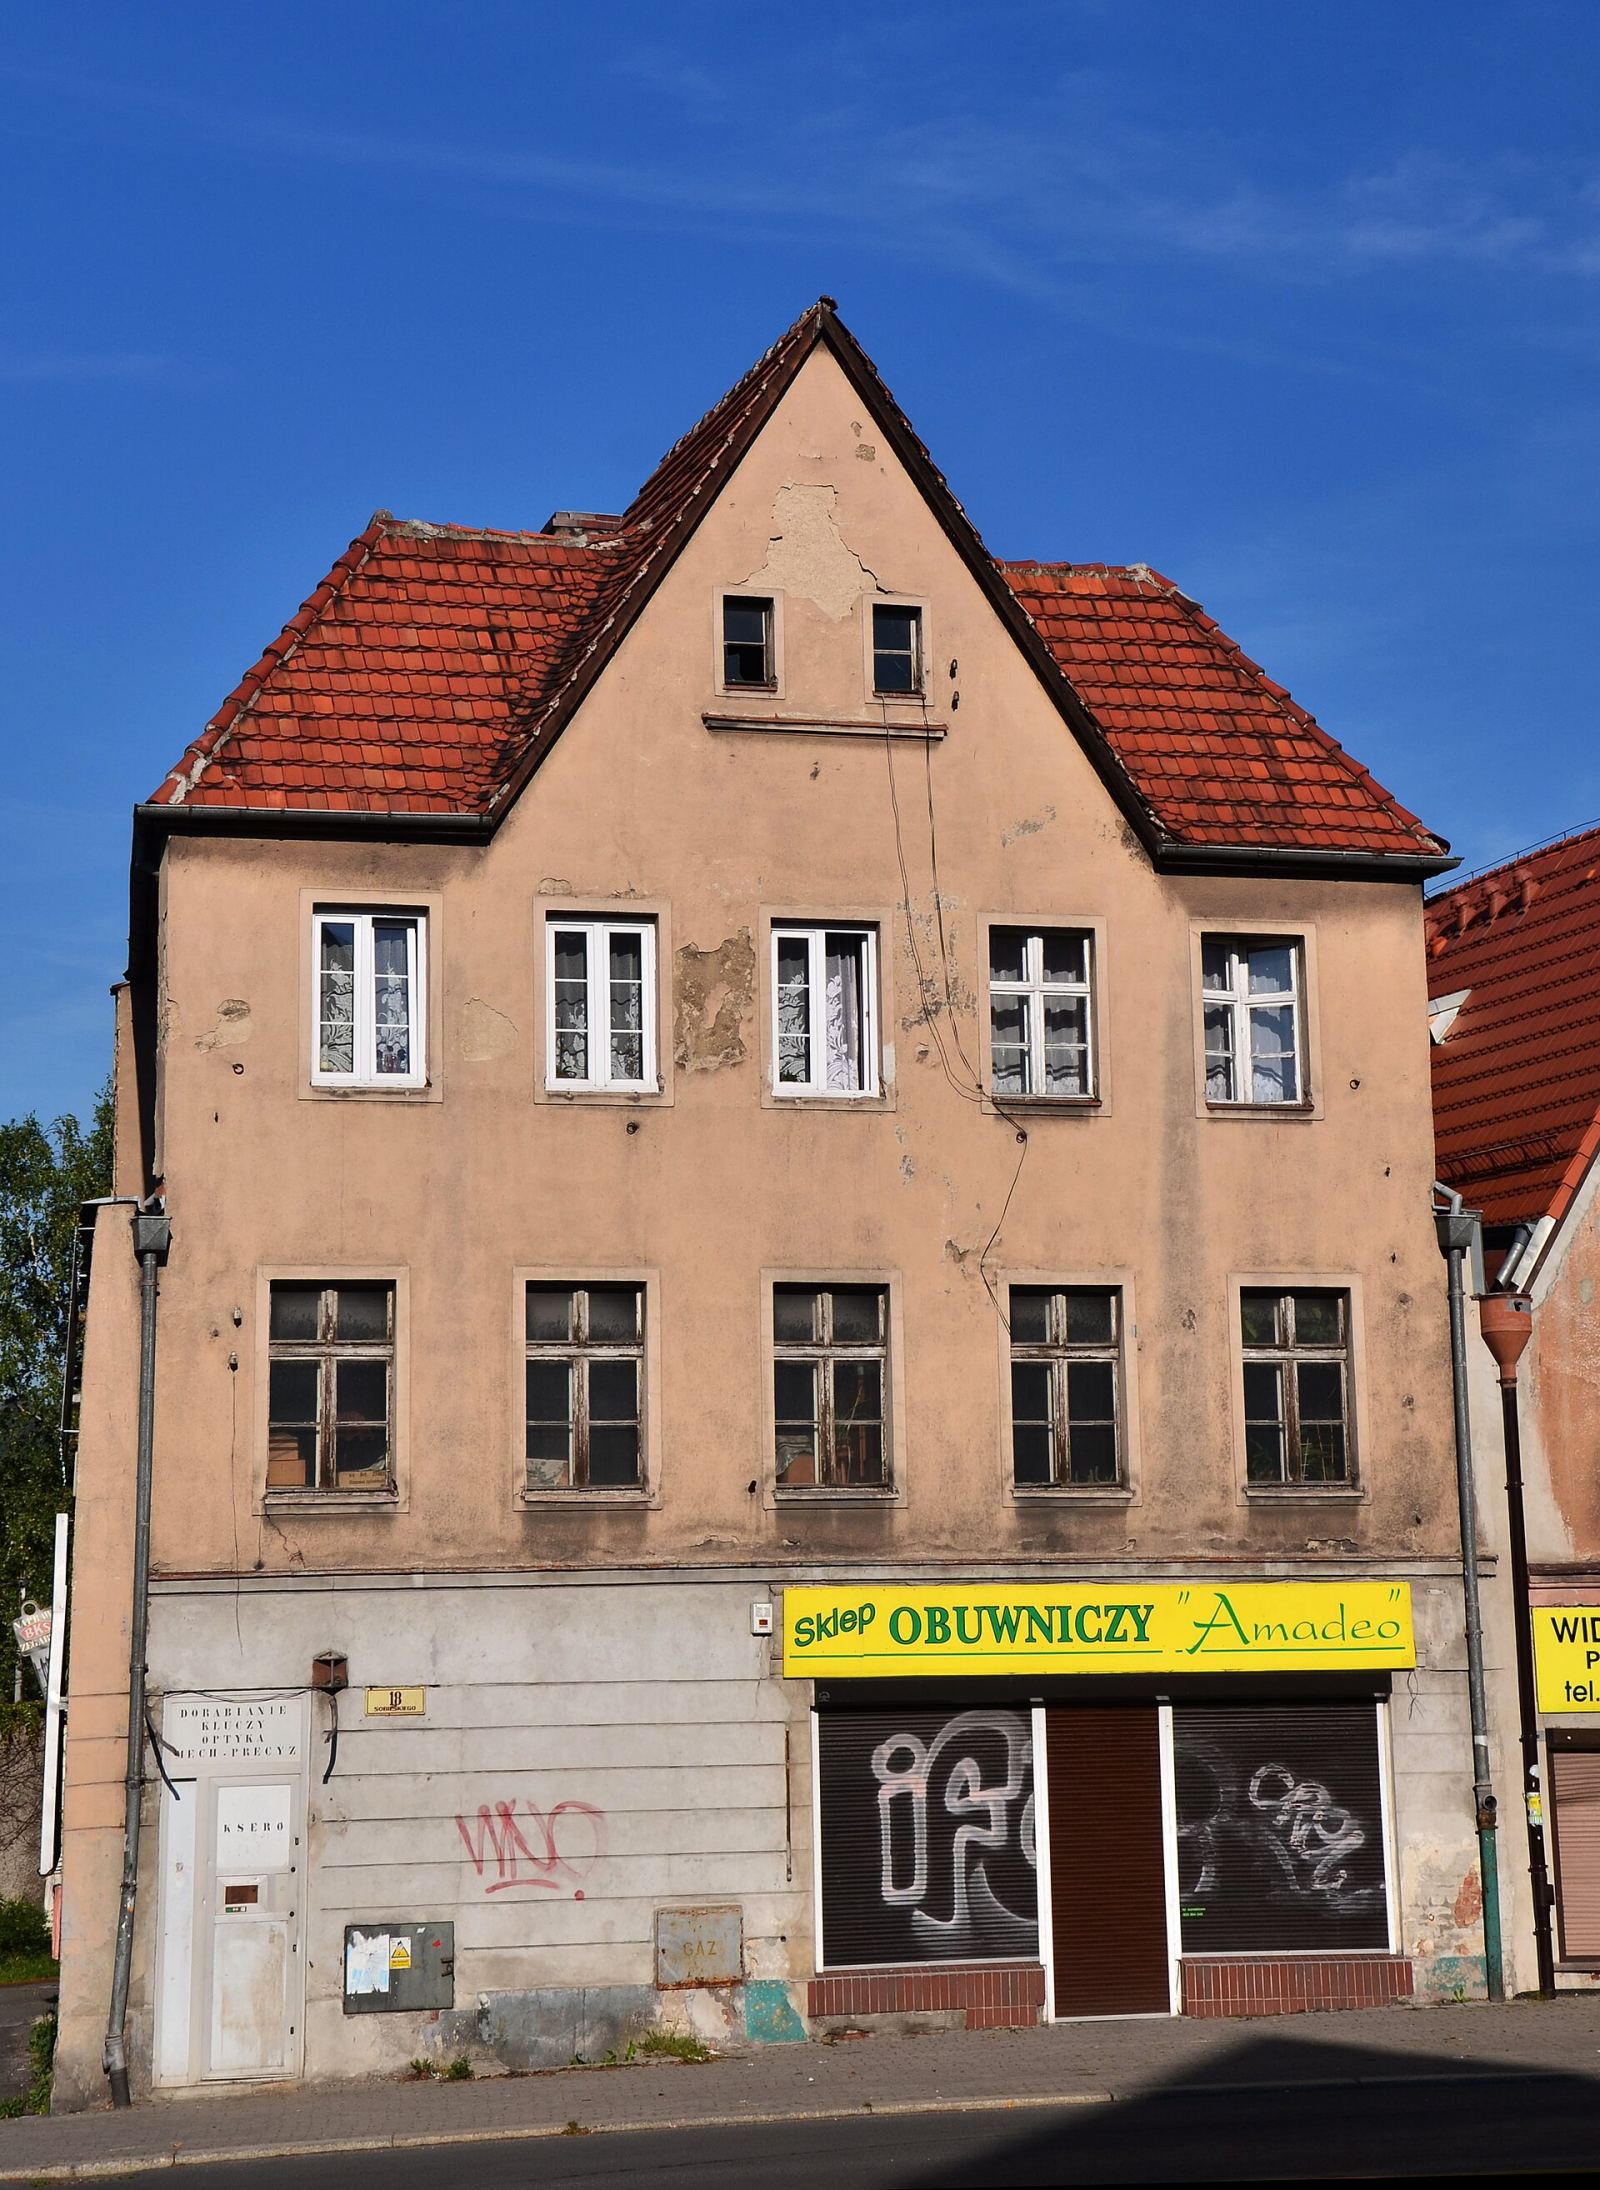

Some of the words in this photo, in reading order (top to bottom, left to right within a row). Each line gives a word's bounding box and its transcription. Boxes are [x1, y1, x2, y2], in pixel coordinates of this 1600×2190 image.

[794, 1602, 876, 1647] Sklep
[888, 1604, 1155, 1645] OBUWNICZY
[1565, 1680, 1600, 1702] tel.
[389, 1691, 402, 1706] 18
[180, 1705, 287, 1718] DORABIANIE
[201, 1720, 265, 1731] KLUCZY
[201, 1734, 264, 1744] OPTYKA
[223, 1822, 284, 1833] KSERO
[683, 1941, 718, 1956] GAZ
